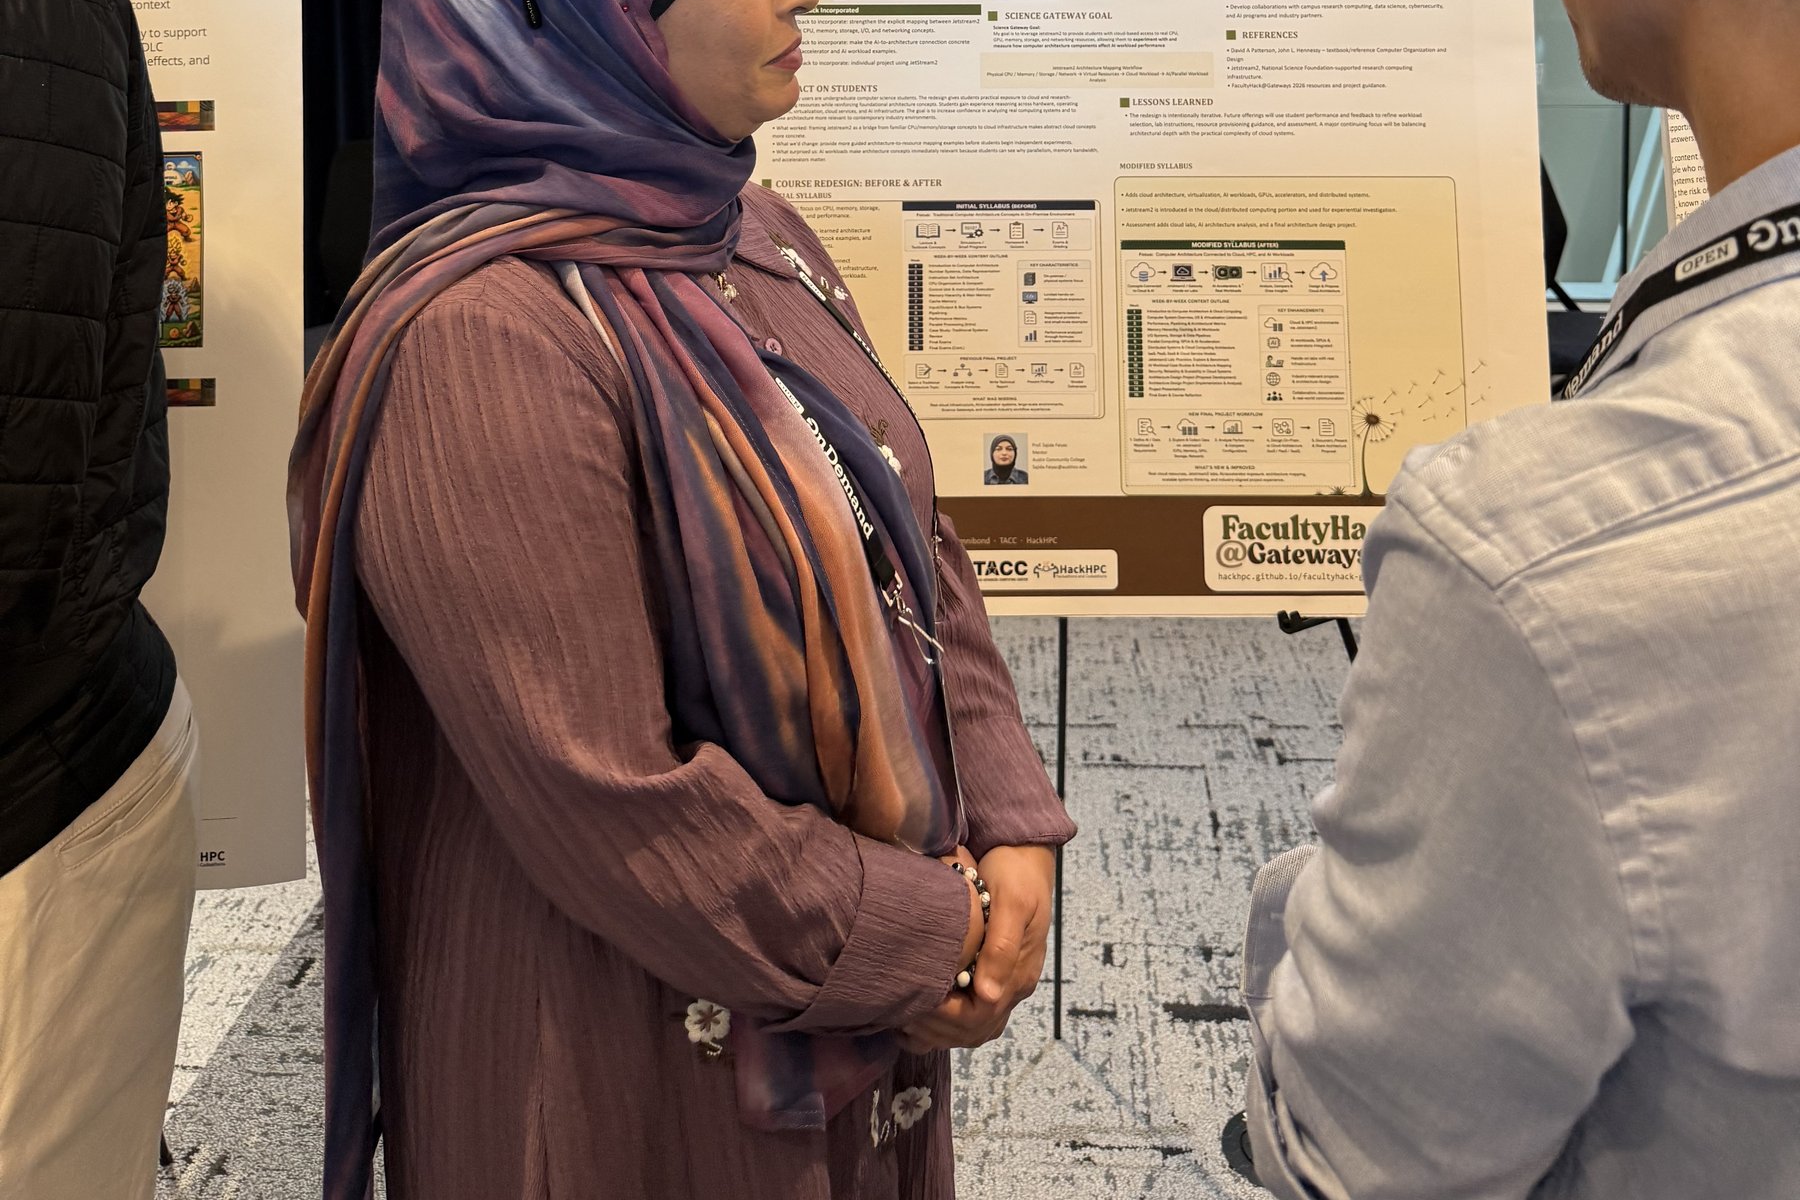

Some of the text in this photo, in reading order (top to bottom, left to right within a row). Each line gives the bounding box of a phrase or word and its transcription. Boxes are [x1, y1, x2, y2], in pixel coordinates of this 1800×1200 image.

[775, 180, 812, 188] COURSE
[1682, 243, 1729, 273] OPEN
[806, 416, 874, 540] OnDemand
[1222, 514, 1366, 545] FacultyHa
[974, 561, 1106, 575] TACC HackHPC
[200, 851, 225, 861] HPC
